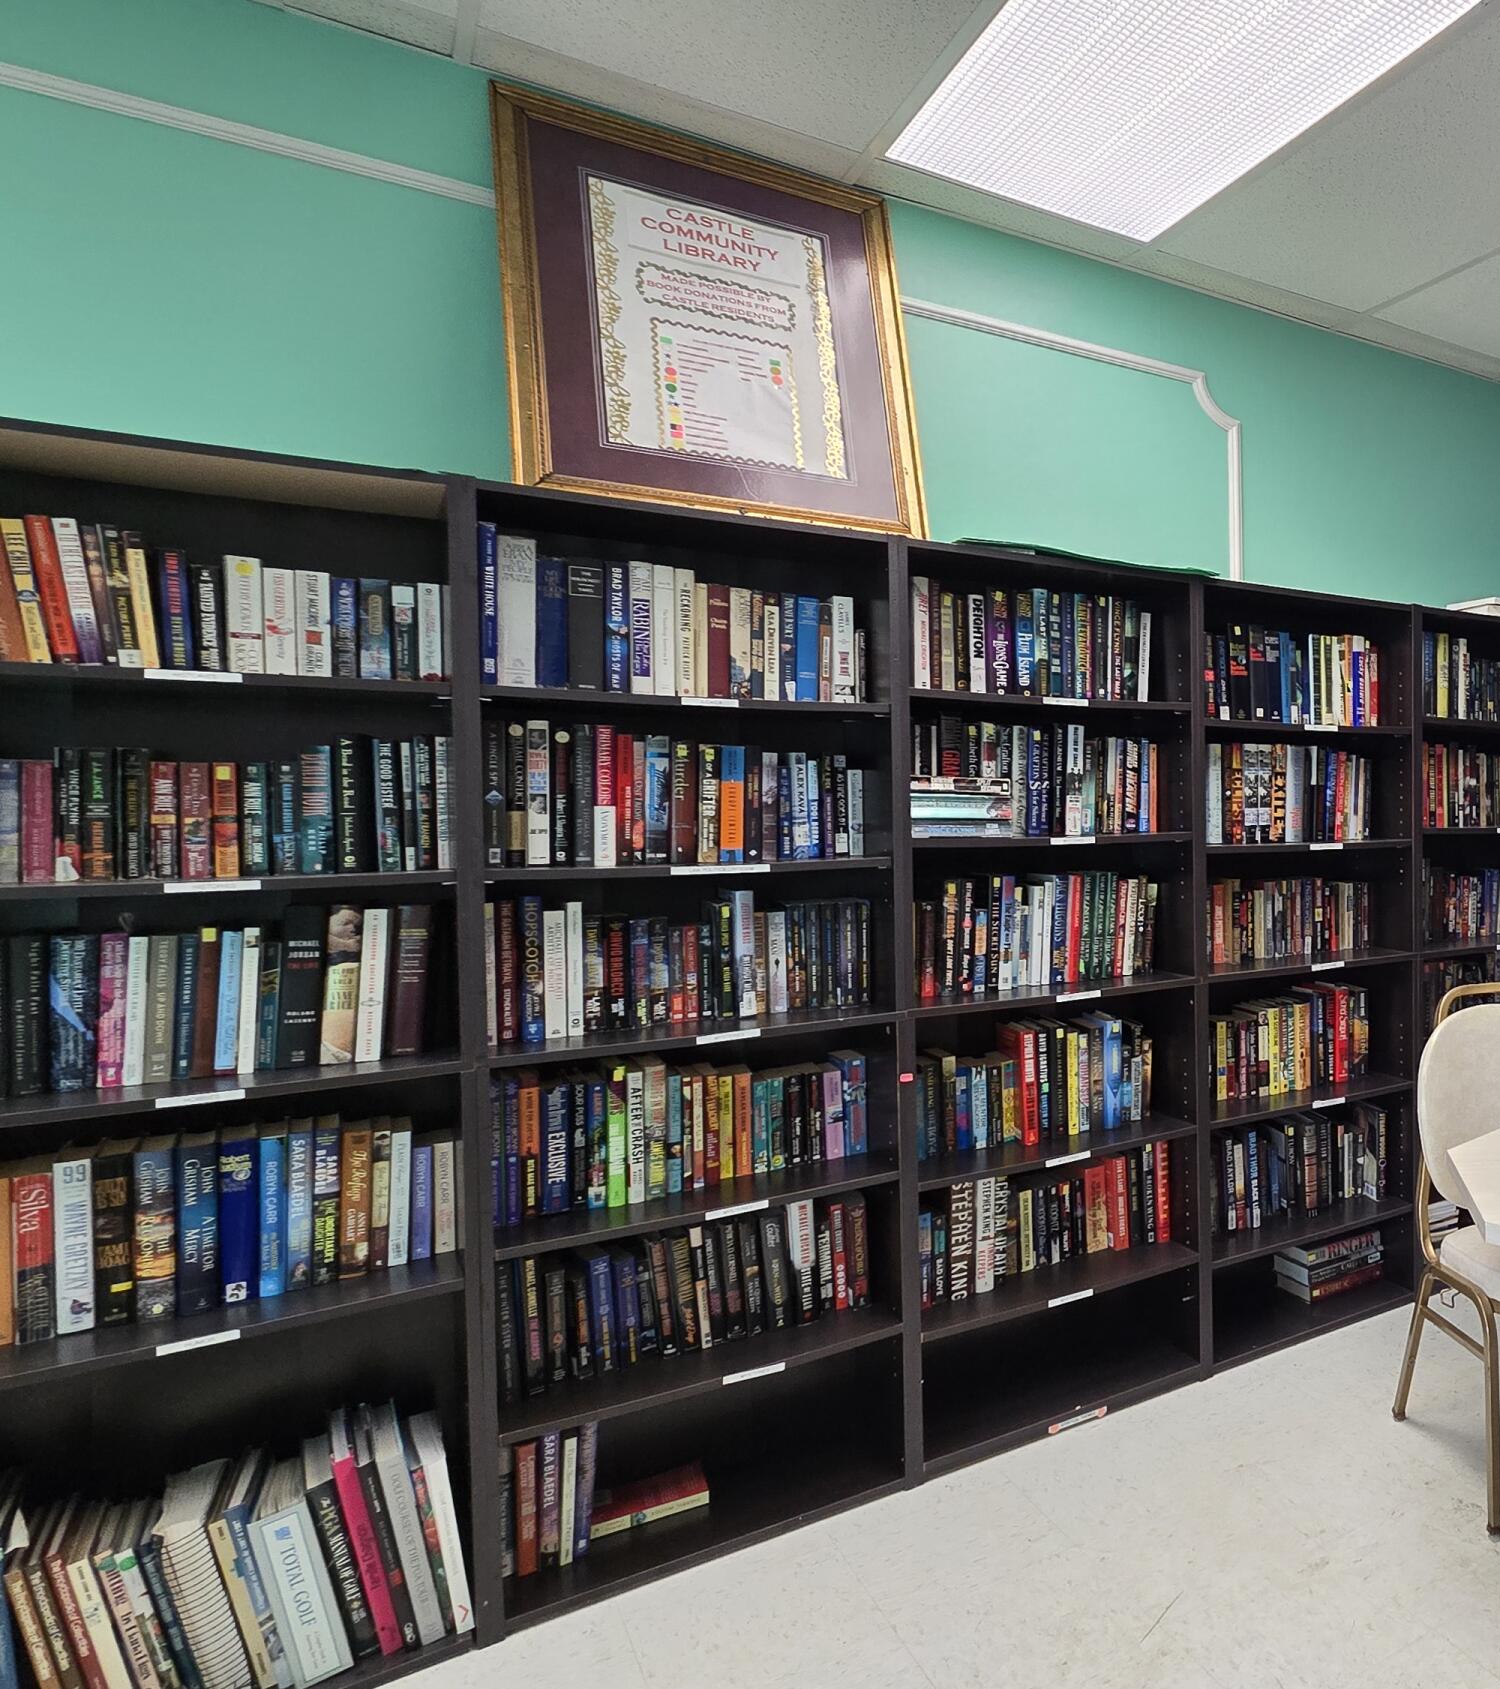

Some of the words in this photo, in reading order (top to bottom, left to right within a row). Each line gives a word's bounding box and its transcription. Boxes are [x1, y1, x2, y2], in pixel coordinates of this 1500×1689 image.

[666, 208, 755, 241] CASTLE
[641, 217, 779, 260] COMMUNITY
[663, 239, 761, 272] LIBRARY
[647, 280, 681, 294] BOOK
[755, 303, 786, 316] FROM
[662, 293, 709, 309] CASTLE
[711, 303, 775, 322] RESIDENTS
[5, 533, 23, 546] LEE
[58, 533, 77, 542] TO
[8, 550, 29, 575] CHILD
[59, 545, 78, 558] THE
[61, 560, 83, 580] LAST
[483, 566, 494, 589] WHITE
[610, 567, 623, 590] BRAD
[65, 582, 89, 609] BREATH
[199, 583, 214, 610] TAINTED
[484, 591, 495, 616] HOUSE
[610, 592, 623, 621] TAYLOR
[633, 601, 649, 639] RABIN
[679, 589, 692, 632] RECKONING
[201, 613, 217, 647] EVIDENCE
[973, 598, 984, 658] DEIGHTON
[1019, 633, 1032, 653] PLUM
[993, 662, 1008, 686] GAME
[1019, 657, 1033, 686] ISLAND
[341, 748, 351, 764] Bend
[380, 743, 389, 757] THE
[599, 729, 612, 766] PRIMARY
[302, 754, 328, 786] BERLIN
[381, 759, 390, 779] GOOD
[1032, 744, 1040, 779] GRAFTON
[69, 769, 78, 794] VINCE
[155, 778, 172, 793] ANN
[245, 781, 261, 796] ANN
[342, 778, 352, 787] the
[600, 768, 613, 805] COLORS
[796, 767, 804, 788] ALEX
[156, 795, 173, 812] RULE
[245, 798, 261, 814] RULE
[302, 791, 328, 816] NOIR
[343, 790, 353, 808] Road
[381, 782, 392, 808] SISTER
[797, 790, 805, 814] KAVA
[1232, 768, 1242, 825] ECLIPSE
[1274, 772, 1285, 825] EXILE
[70, 796, 78, 824] FLYNN
[127, 832, 137, 848] DAVID
[318, 826, 326, 854] PHILIP
[1055, 879, 1066, 900] JACK
[1055, 903, 1066, 942] HIGGINS
[1137, 899, 1146, 926] Leon
[28, 943, 40, 965] Night
[524, 903, 539, 982] HOPSCOTCH
[611, 931, 622, 955] DAVID
[183, 948, 193, 972] WINTER
[30, 971, 40, 992] Falls
[181, 975, 192, 1004] STORMS
[611, 957, 623, 996] BALDACCI
[30, 997, 40, 1015] Fast
[155, 992, 166, 1000] UP
[155, 1003, 165, 1018] AND
[154, 1020, 165, 1044] DOWN
[1039, 1033, 1048, 1052] DAVID
[1039, 1054, 1048, 1082] IGNATIUS
[631, 1087, 643, 1120] AFTER
[291, 1139, 306, 1169] SARA
[548, 1133, 566, 1184] EXCLUSIVE
[632, 1128, 643, 1164] CRASH
[63, 1163, 87, 1184] 99
[265, 1161, 278, 1190] ROBYN
[327, 1156, 338, 1180] SARA
[416, 1153, 427, 1178] ROBYN
[438, 1152, 449, 1176] ROBYN
[139, 1161, 154, 1205] GRISHAM
[155, 1167, 170, 1194] JOHN
[183, 1160, 199, 1206] GRISHAM
[200, 1165, 214, 1193] JOHN
[439, 1180, 450, 1204] CARR
[290, 1172, 306, 1218] BLAEDEL
[416, 1181, 427, 1208] CARR
[982, 1181, 992, 1213] STEPHEN
[995, 1181, 1007, 1232] CRYSTAL
[19, 1189, 47, 1234] Silva
[63, 1201, 85, 1242] WAYNE
[265, 1193, 278, 1224] CARR
[951, 1184, 966, 1255] STEPHEN
[202, 1226, 215, 1249] TIME
[983, 1216, 991, 1234] KING
[184, 1230, 199, 1263] MERCY
[818, 1231, 831, 1284] TERMINAL
[64, 1246, 89, 1291] GRETZKY
[201, 1252, 215, 1271] FOR
[525, 1259, 536, 1286] MICHAEL
[935, 1258, 943, 1274] BAD
[952, 1262, 967, 1301] KING
[527, 1287, 538, 1317] CONNELLY
[544, 1435, 557, 1465] SARA
[543, 1465, 556, 1508] BLAEDEL
[280, 1544, 304, 1590] TOTAL
[294, 1591, 315, 1627] GOLF
